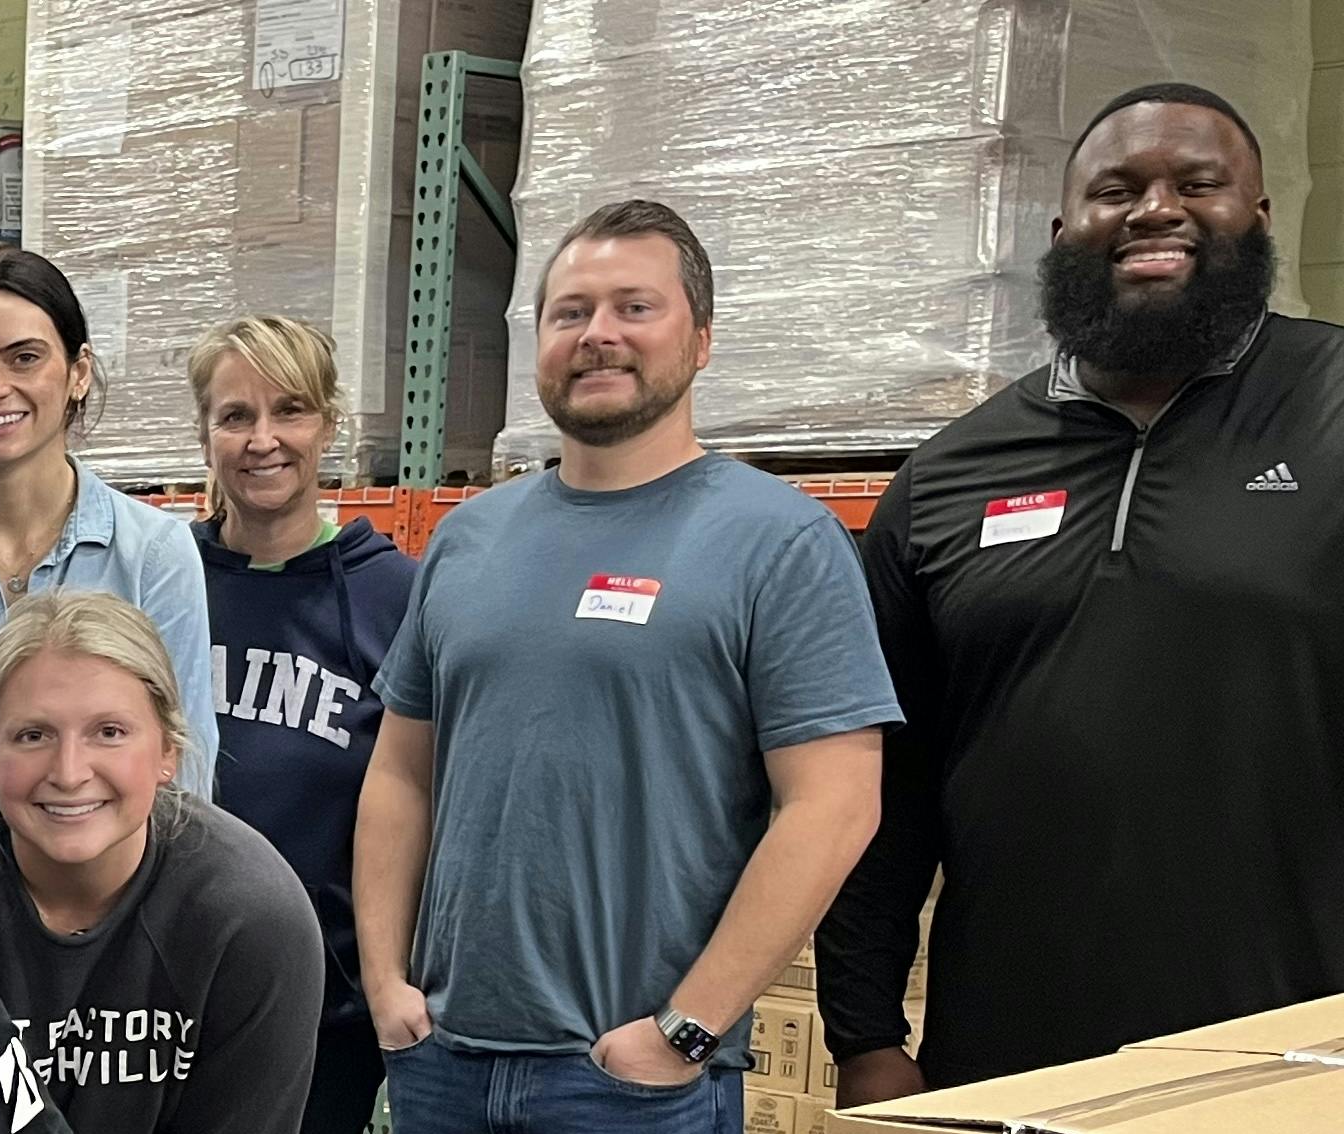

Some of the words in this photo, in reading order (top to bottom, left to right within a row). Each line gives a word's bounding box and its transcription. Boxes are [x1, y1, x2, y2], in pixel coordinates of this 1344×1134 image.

[1006, 494, 1045, 508] HELLO
[606, 577, 641, 588] HELLO
[588, 595, 635, 615] Daniel
[211, 645, 361, 750] AINE
[32, 1046, 195, 1087] SHVILLE
